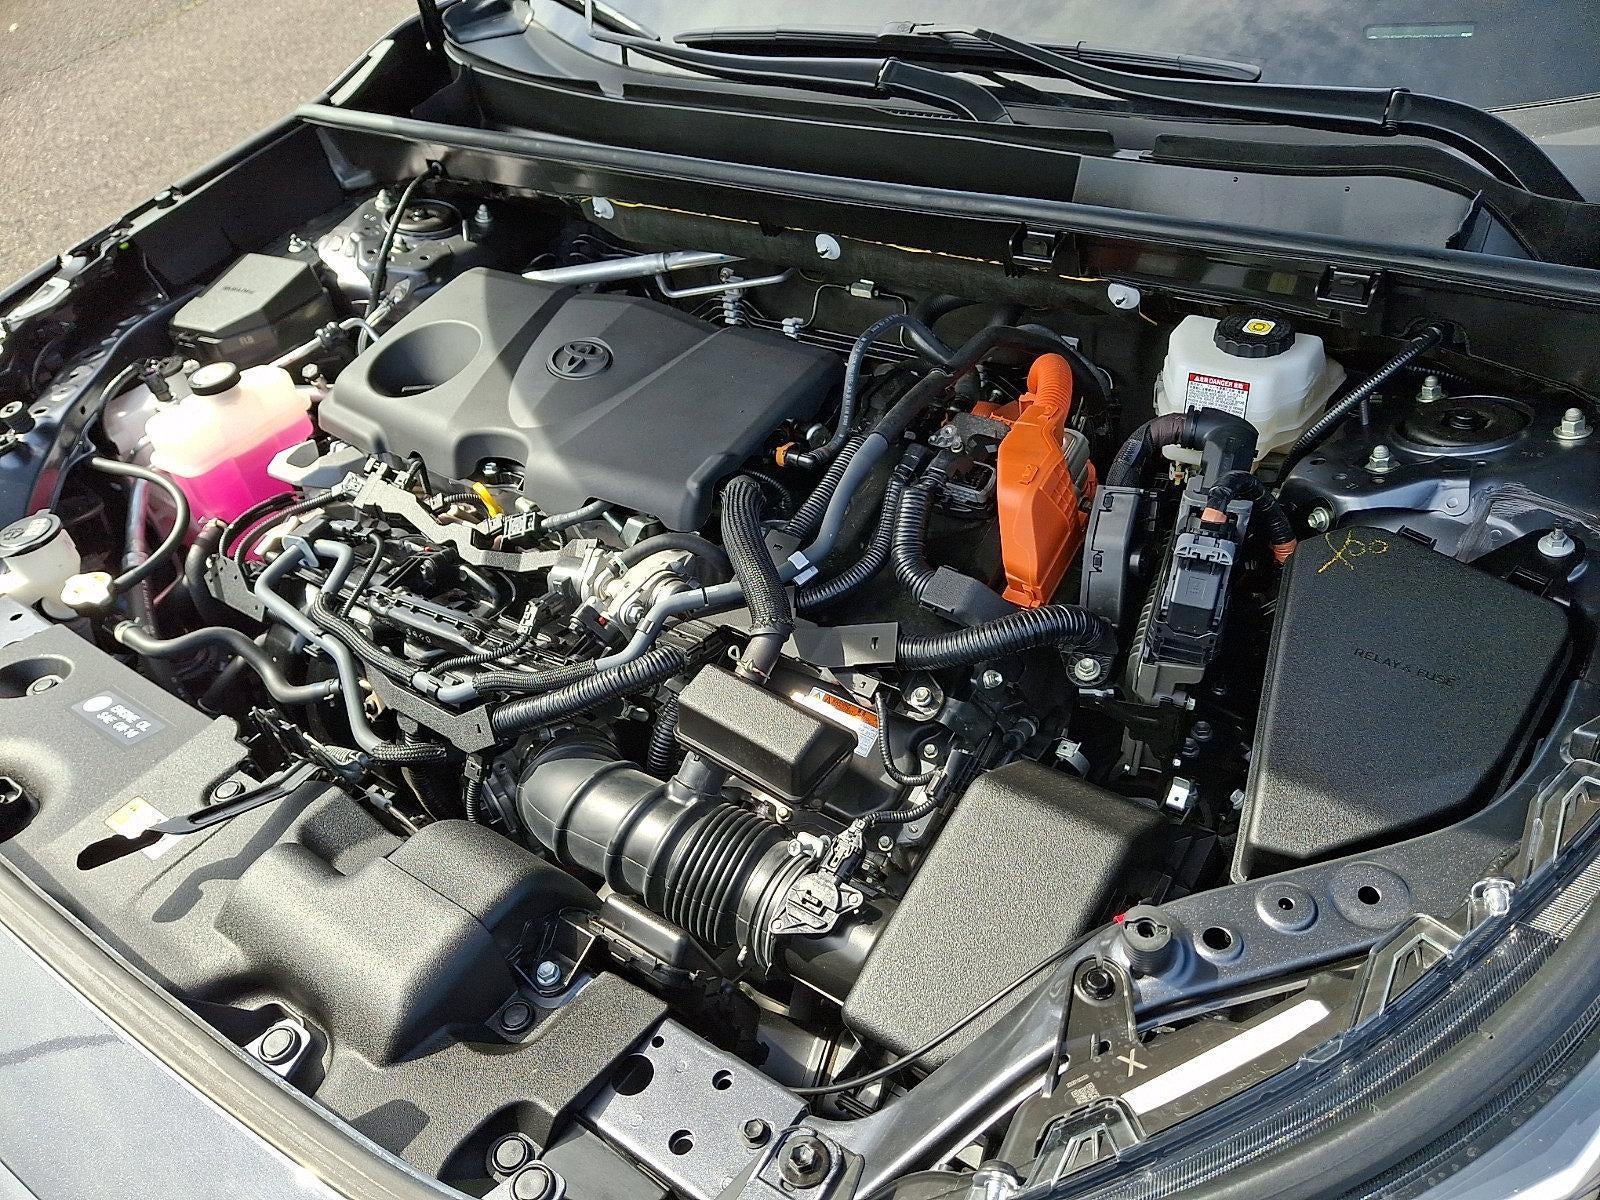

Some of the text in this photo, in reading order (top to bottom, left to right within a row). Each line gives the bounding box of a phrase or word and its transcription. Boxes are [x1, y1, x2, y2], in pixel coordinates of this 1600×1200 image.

[1209, 378, 1233, 387] DANGER
[1354, 648, 1401, 669] RELAY
[1417, 668, 1456, 687] FUSE
